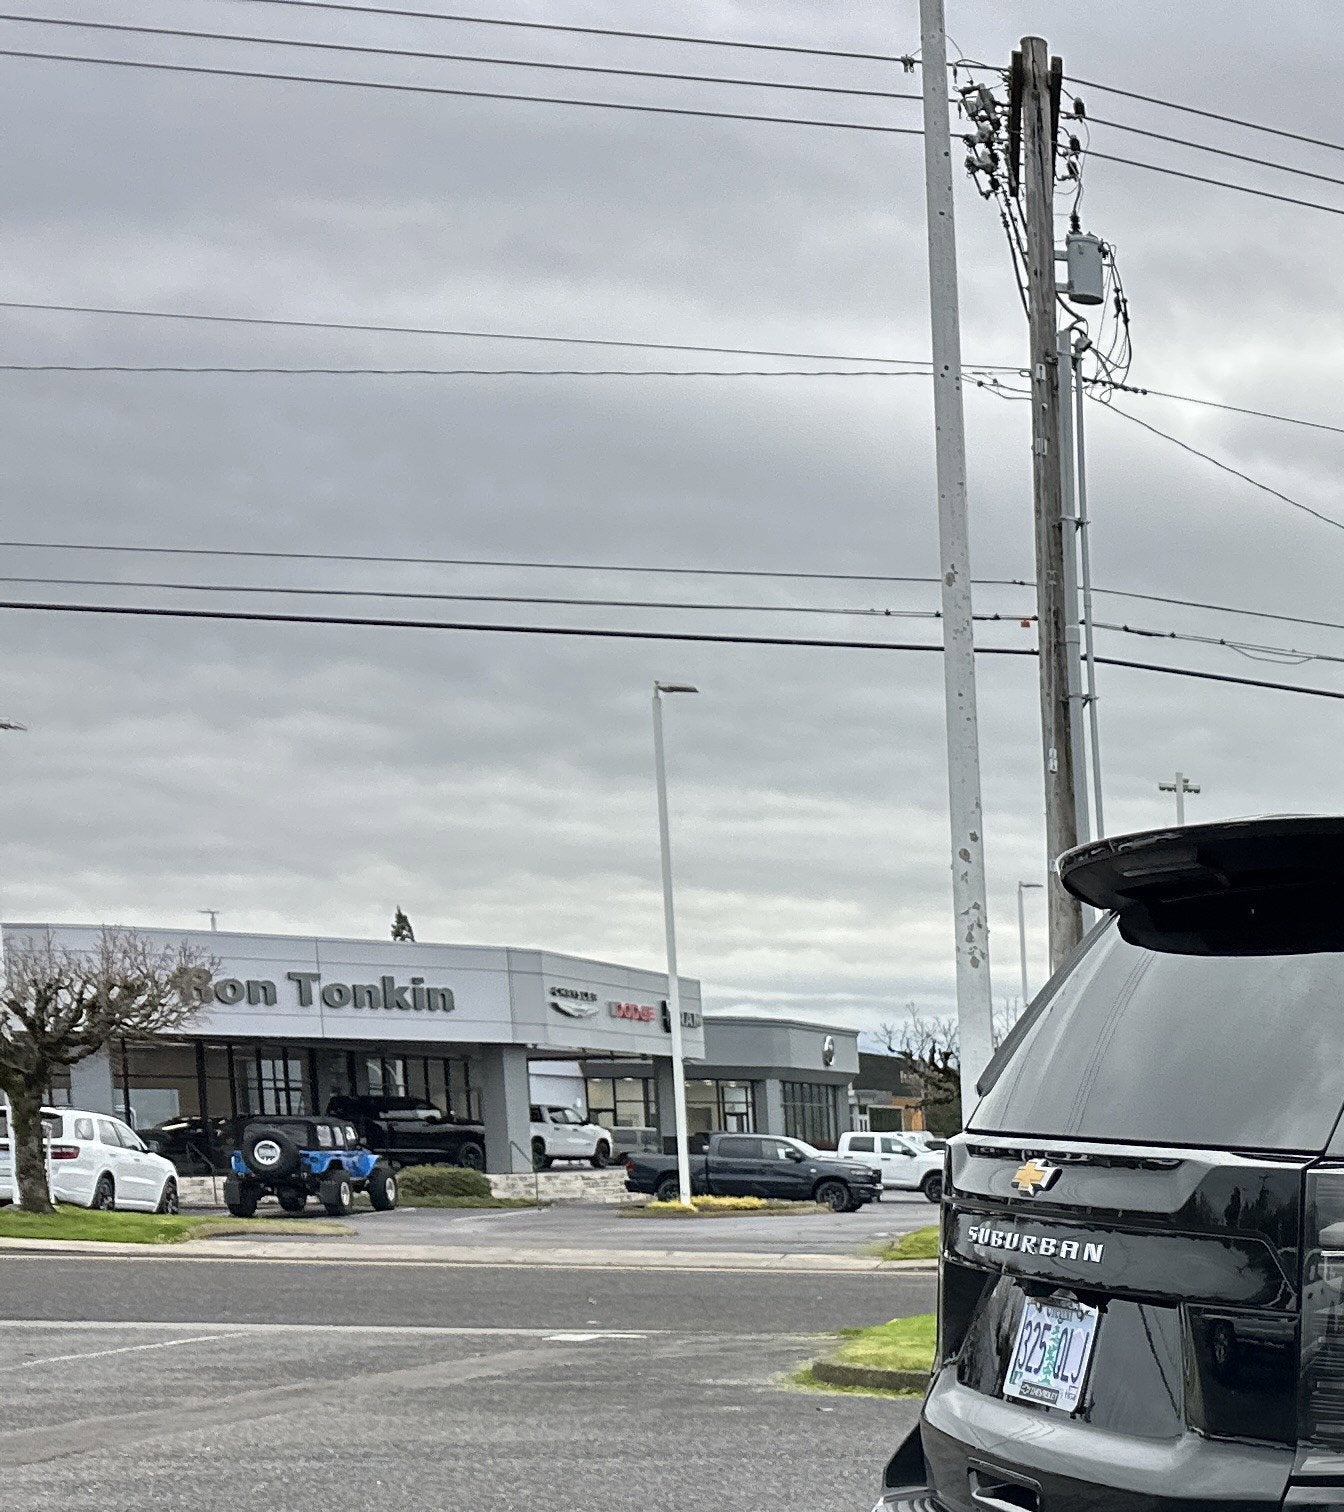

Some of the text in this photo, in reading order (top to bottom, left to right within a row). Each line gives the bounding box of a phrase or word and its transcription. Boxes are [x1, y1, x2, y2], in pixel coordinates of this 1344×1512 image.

[287, 971, 456, 1011] Tonkin
[967, 1226, 1105, 1263] SUBURBAN
[1017, 1319, 1052, 1375] 325
